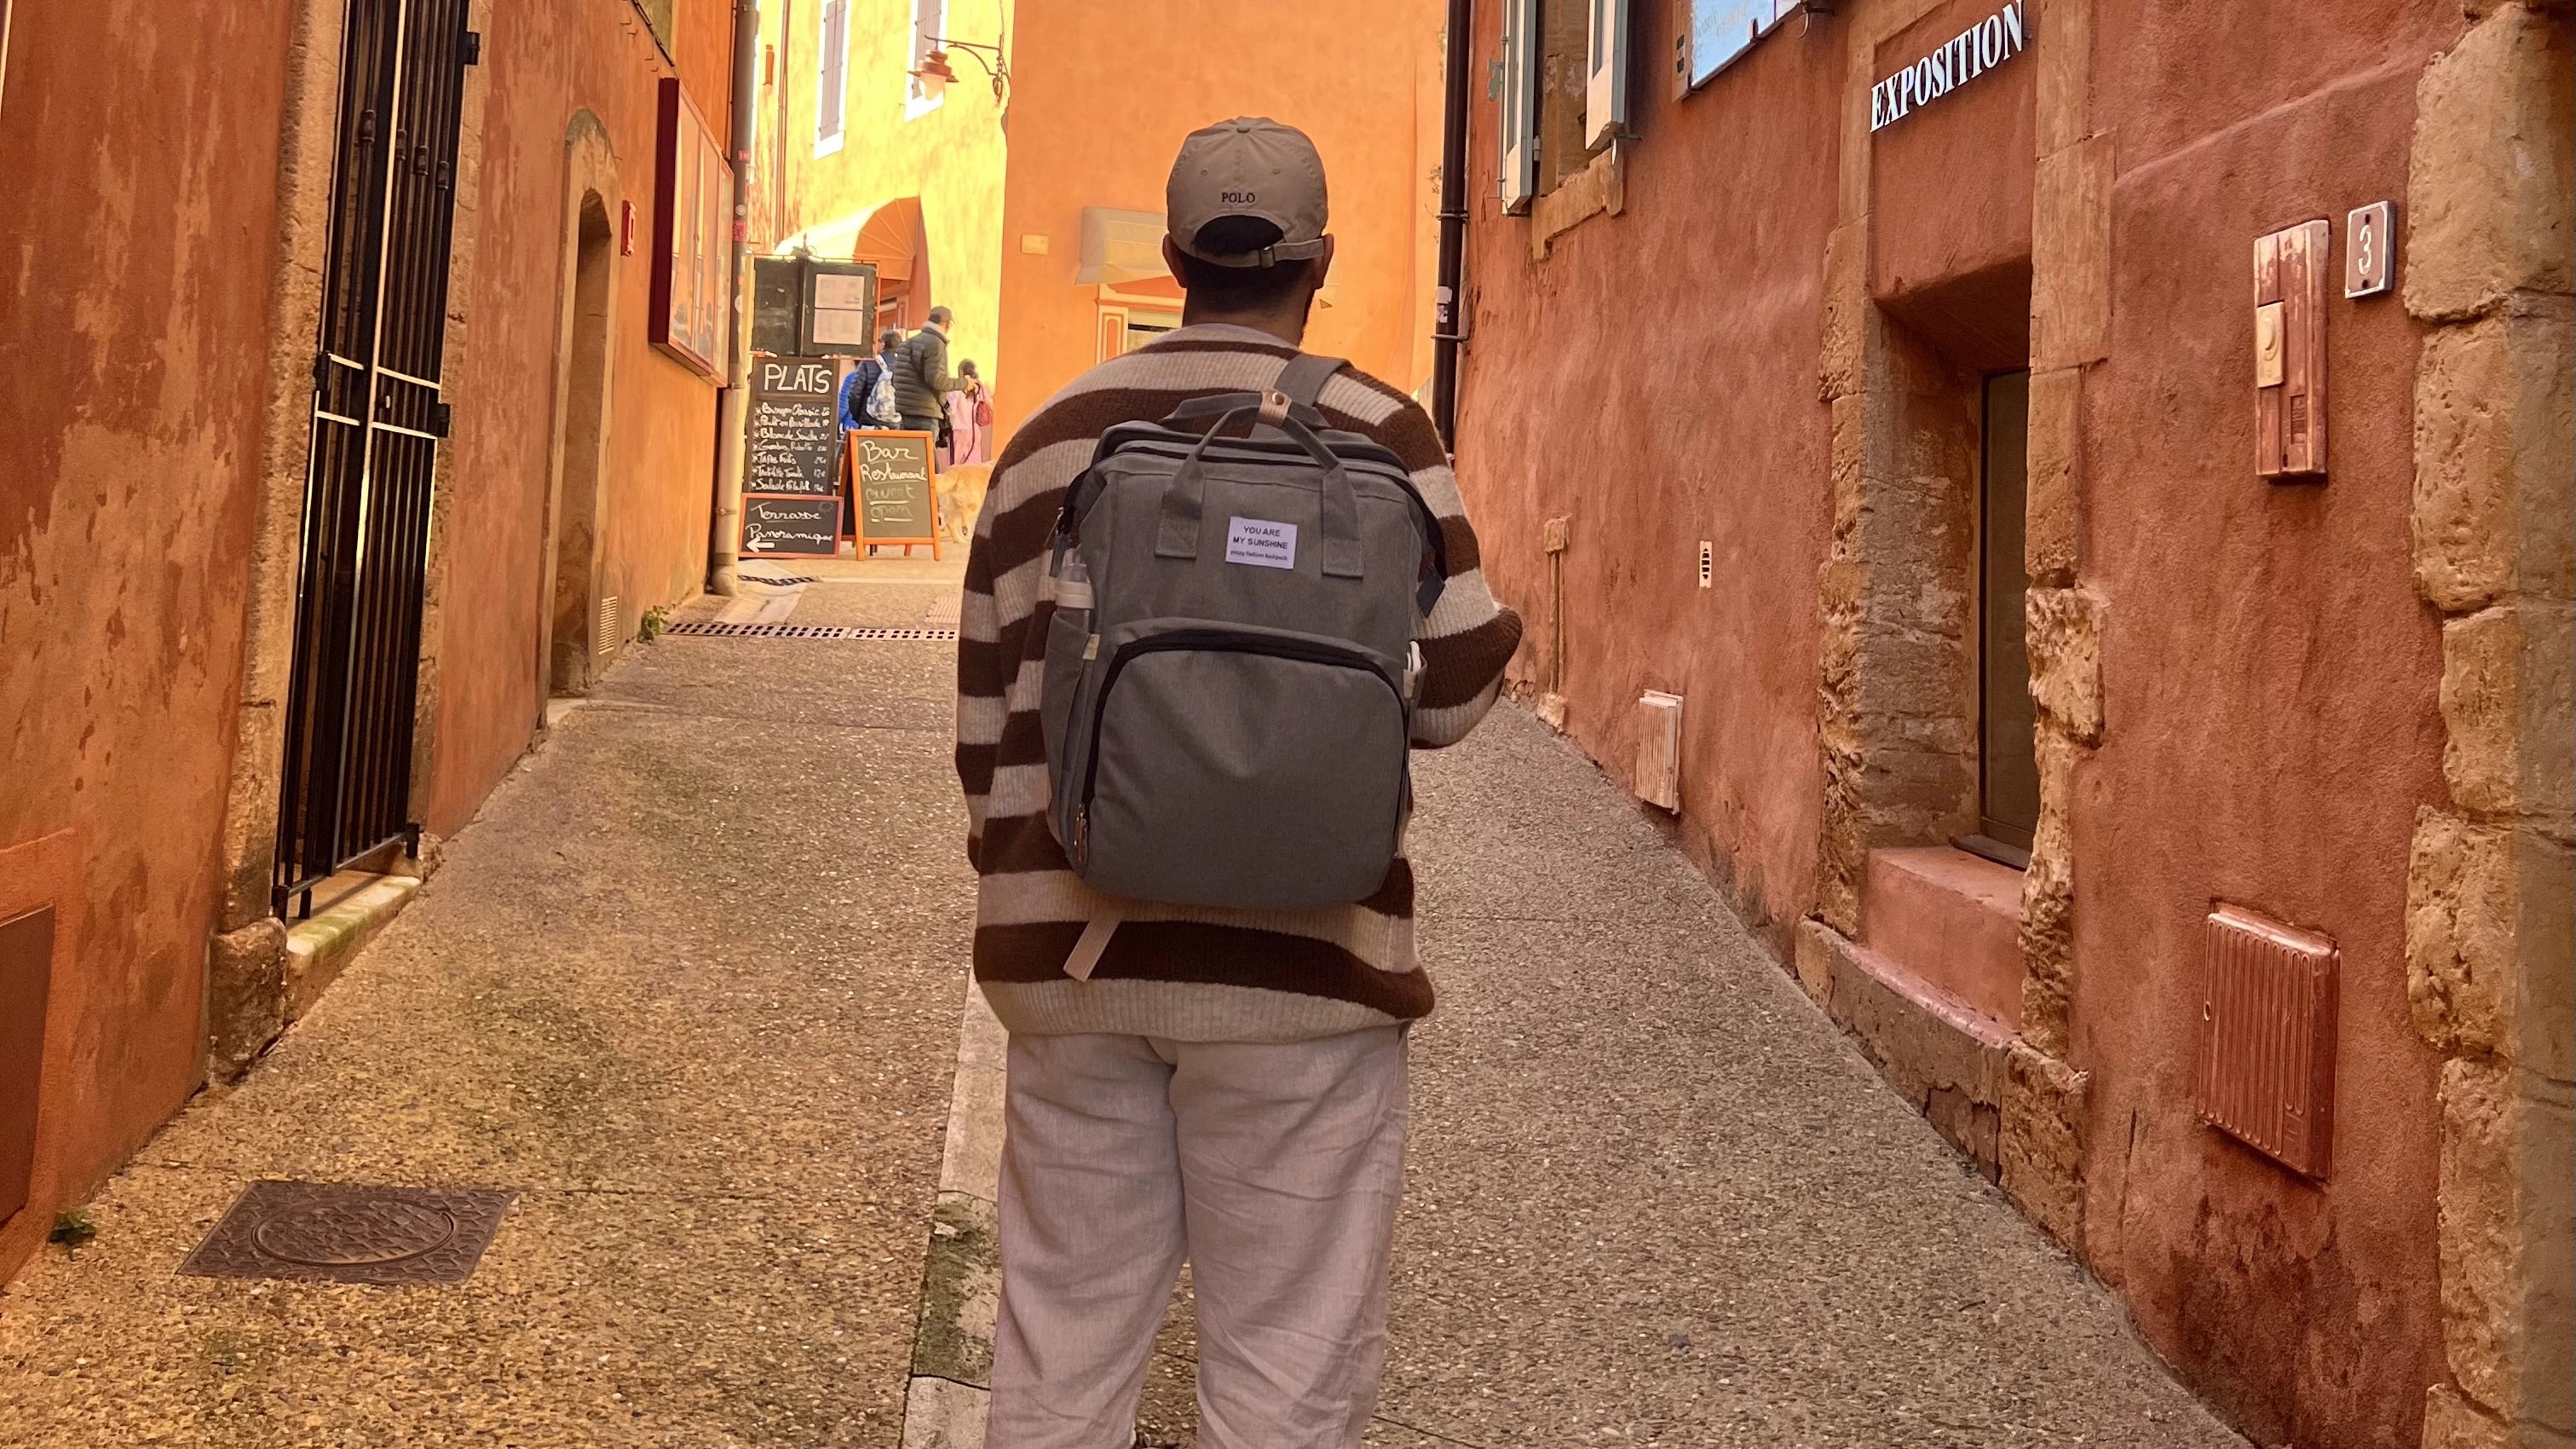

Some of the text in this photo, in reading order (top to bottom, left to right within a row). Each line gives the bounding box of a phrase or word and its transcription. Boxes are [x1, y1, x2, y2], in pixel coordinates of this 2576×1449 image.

[1870, 0, 2024, 132] EXPOSITION
[1221, 192, 1255, 203] POLO
[2358, 224, 2371, 275] 3
[764, 363, 833, 394] PLATS
[860, 440, 919, 462] Bar
[750, 501, 821, 520] Terrasse
[1262, 528, 1281, 537] ARE
[1248, 538, 1288, 550] SUNSHINE
